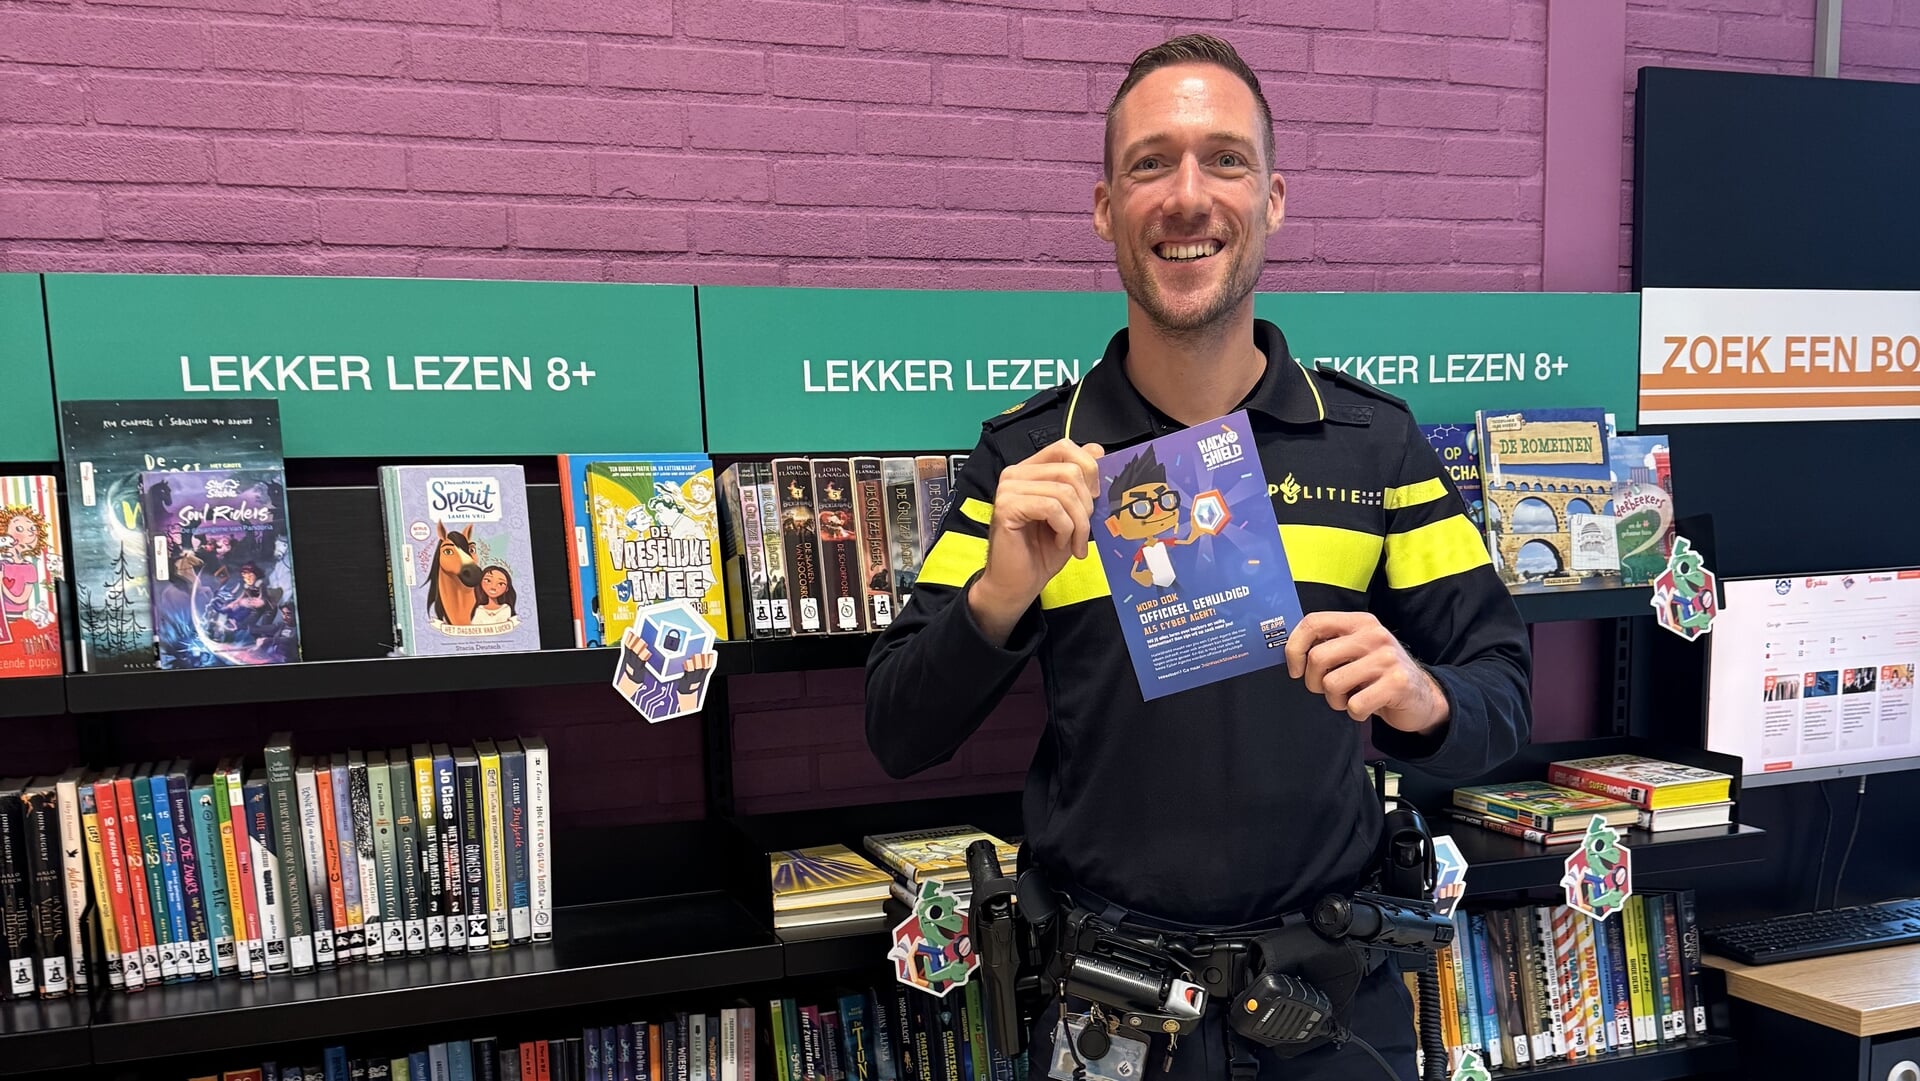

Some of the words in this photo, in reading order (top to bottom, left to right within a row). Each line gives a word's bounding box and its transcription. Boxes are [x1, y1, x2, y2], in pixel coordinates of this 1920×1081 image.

[1663, 336, 1772, 374] ZOEK
[1785, 336, 1857, 373] EEN
[180, 355, 372, 392] LEKKER
[387, 355, 533, 391] LEZEN
[546, 357, 596, 392] 8+
[803, 359, 953, 392] LEKKER
[965, 359, 1080, 390] LEZEN
[1430, 353, 1525, 383] LEZEN
[1534, 353, 1568, 380] 8+
[1197, 433, 1228, 454] HACK
[1444, 447, 1462, 459] OP
[1500, 439, 1517, 454] DE
[1520, 437, 1592, 453] ROMEINEN
[1202, 444, 1242, 467] SHIELD
[432, 481, 496, 513] Spirit
[865, 485, 876, 496] DE
[895, 487, 907, 499] DE
[928, 484, 940, 495] DE
[179, 503, 209, 527] Soul
[212, 501, 269, 524] Riders
[863, 496, 881, 535] GRIJZE
[895, 500, 912, 539] GRIJZE
[650, 525, 668, 539] DE
[610, 537, 712, 570] VRESELIJKE
[795, 543, 804, 560] VAN
[804, 542, 811, 552] DE
[837, 543, 844, 551] DE
[866, 536, 883, 570] JAGER
[898, 540, 913, 570] JAGER
[805, 554, 814, 583] SLAVEN
[627, 571, 705, 602] TWEE
[1136, 599, 1158, 613] WORD
[1161, 593, 1178, 605] OOK
[1139, 603, 1190, 624] OFFICIEEL
[1192, 585, 1249, 610] GEHULDIGD
[1143, 625, 1158, 635] ALS
[1160, 616, 1187, 631] CYBER
[1189, 608, 1217, 622] AGENT!
[29, 657, 58, 670] puppy
[418, 768, 428, 783] Jo
[439, 768, 452, 783] Jo
[376, 782, 384, 800] Erwin
[279, 801, 289, 819] HART
[419, 784, 433, 819] Claes
[440, 785, 455, 819] Claes
[0, 813, 10, 833] JOHN
[36, 810, 44, 830] JOHN
[103, 816, 114, 826] 10
[123, 814, 134, 823] 13
[140, 812, 153, 821] 14
[158, 810, 169, 819] 15
[254, 811, 266, 831] OLLIE
[280, 819, 290, 833] VAN
[426, 825, 436, 841] NIET
[447, 825, 457, 842] NIET
[3, 834, 13, 863] AUGUST
[39, 832, 47, 861] AUGUST
[283, 833, 292, 845] EEN
[403, 837, 415, 877] Geesten
[427, 843, 438, 863] VOOR
[448, 843, 459, 863] VOOR
[286, 865, 295, 873] IS
[367, 868, 375, 886] David
[405, 886, 418, 920] gekken
[429, 900, 437, 911] 3
[450, 901, 459, 912] 2
[1683, 932, 1691, 958] CATS
[1630, 958, 1639, 993] BROEDERS
[632, 1030, 645, 1049] Danny
